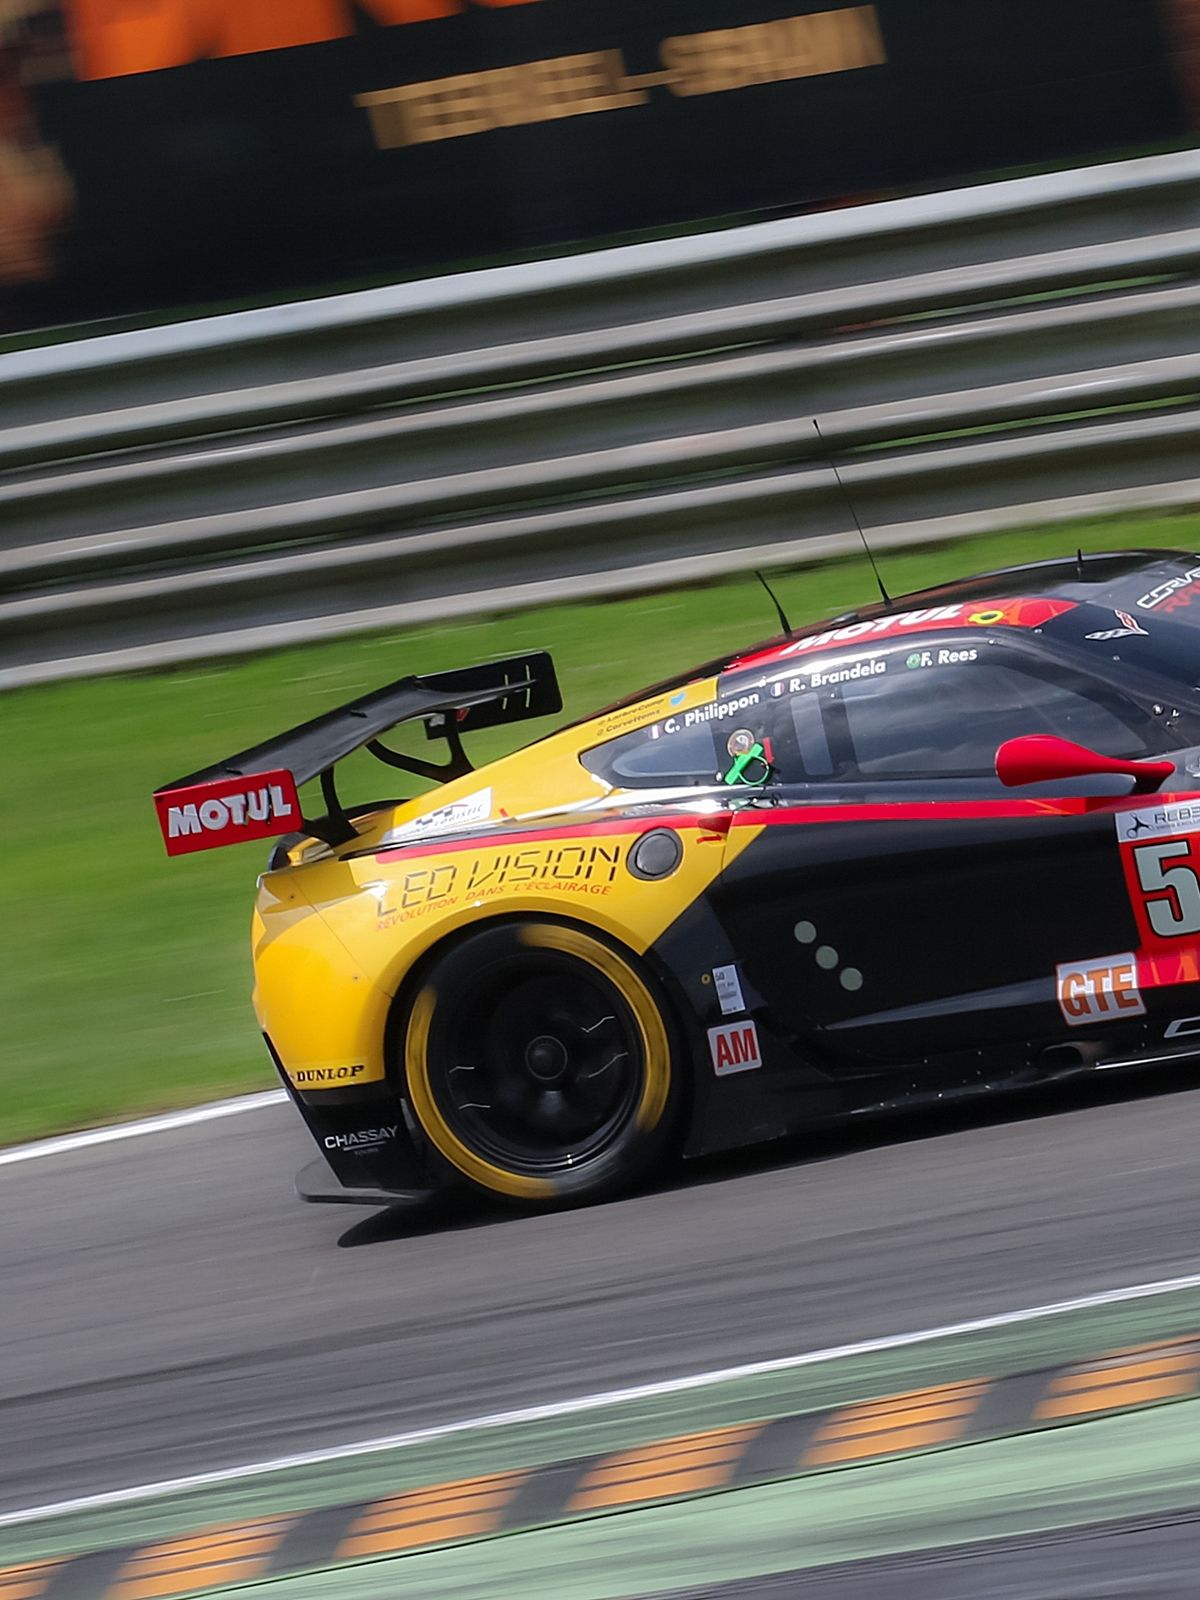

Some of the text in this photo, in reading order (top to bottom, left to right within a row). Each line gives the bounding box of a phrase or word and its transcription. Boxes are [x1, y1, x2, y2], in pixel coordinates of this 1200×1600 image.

[778, 604, 964, 656] MOTUL
[789, 660, 886, 693] R. Brandela
[921, 649, 978, 667] F. Rees
[664, 692, 760, 734] C. Philippon
[168, 785, 292, 838] MOTUL
[376, 845, 620, 917] LED VISION
[1062, 964, 1139, 1017] GTE
[716, 1028, 758, 1069] AM
[297, 1065, 365, 1082] DUNLOP
[324, 1125, 398, 1149] CHASSAY
